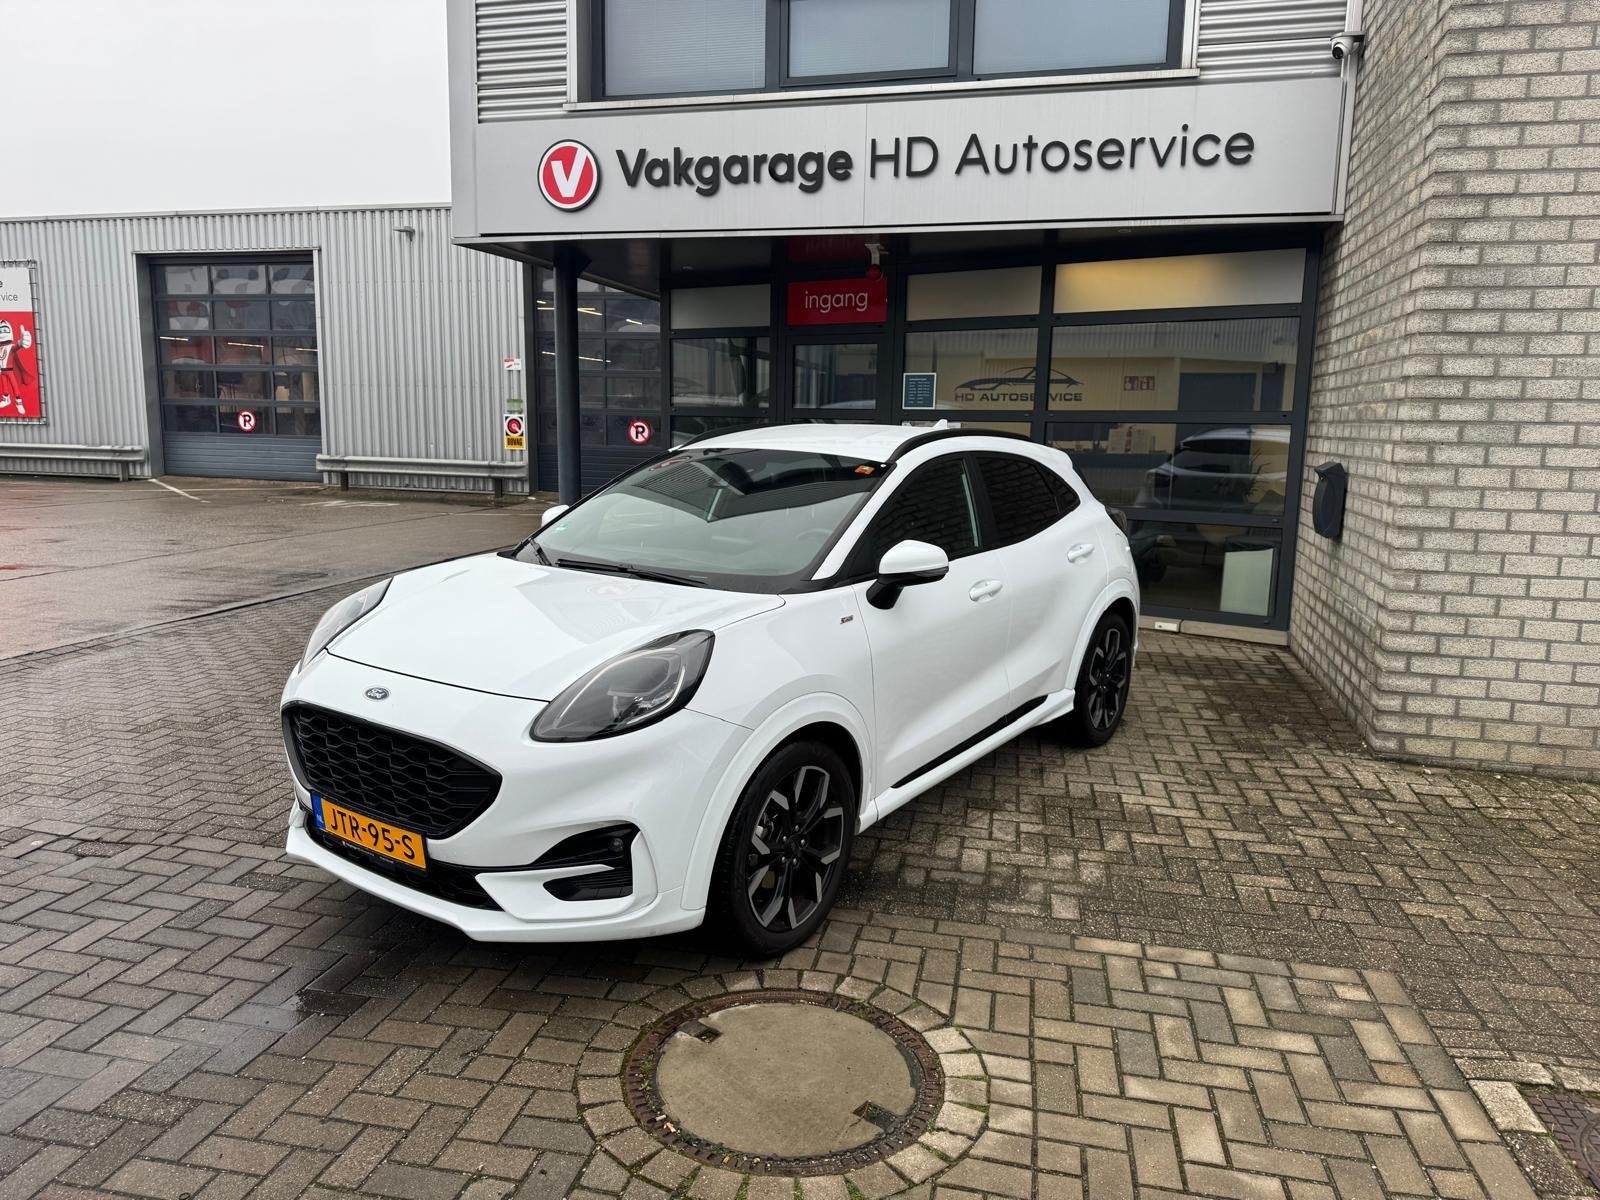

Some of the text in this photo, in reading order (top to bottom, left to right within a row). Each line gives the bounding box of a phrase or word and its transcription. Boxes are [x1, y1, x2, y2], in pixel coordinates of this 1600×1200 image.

[616, 123, 1255, 197] Vakgarage HD Autoservice
[804, 290, 868, 313] ingang
[954, 392, 1083, 402] HD AUTOSEVICE
[330, 808, 415, 860] JTR-95-S
